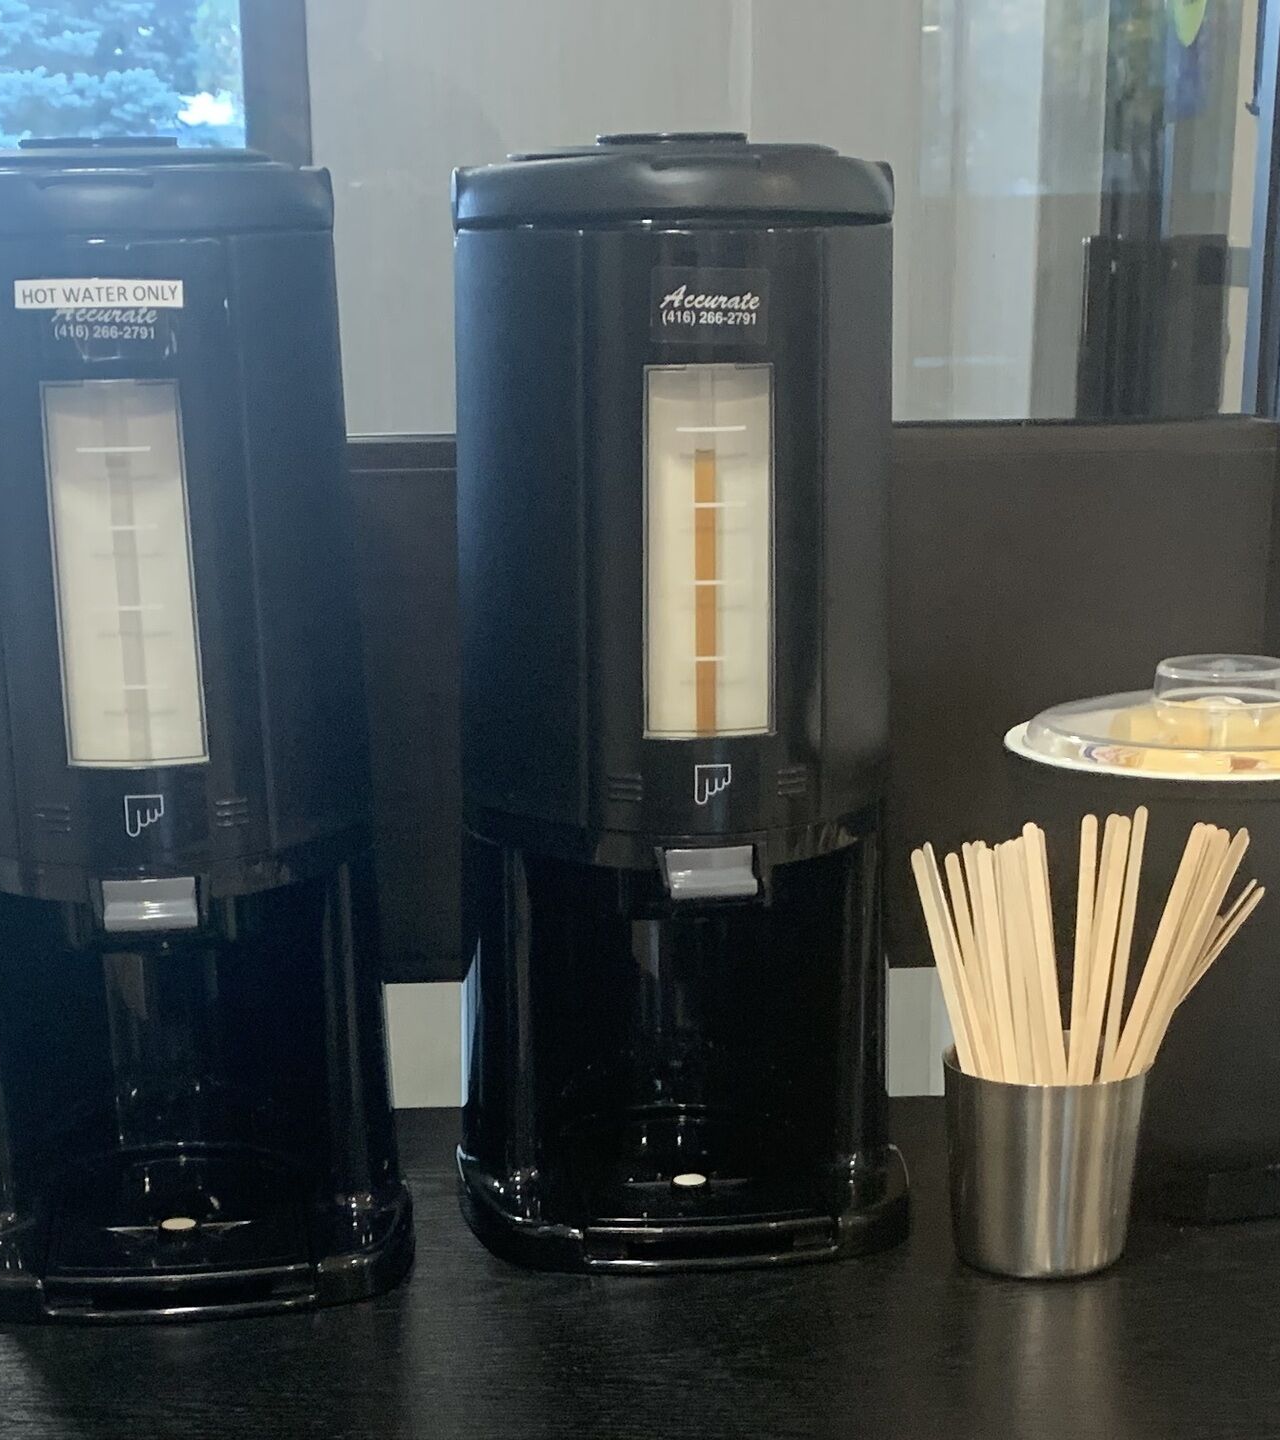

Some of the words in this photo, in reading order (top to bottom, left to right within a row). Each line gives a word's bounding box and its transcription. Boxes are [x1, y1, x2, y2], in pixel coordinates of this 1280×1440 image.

[21, 287, 57, 304] HOT
[63, 286, 128, 303] WATER
[133, 284, 179, 301] ONLY
[659, 284, 760, 310] Accurate
[662, 311, 696, 326] (416)
[699, 311, 757, 325] 266-2791
[54, 325, 89, 340] (416)
[93, 325, 156, 339] 266-2791
